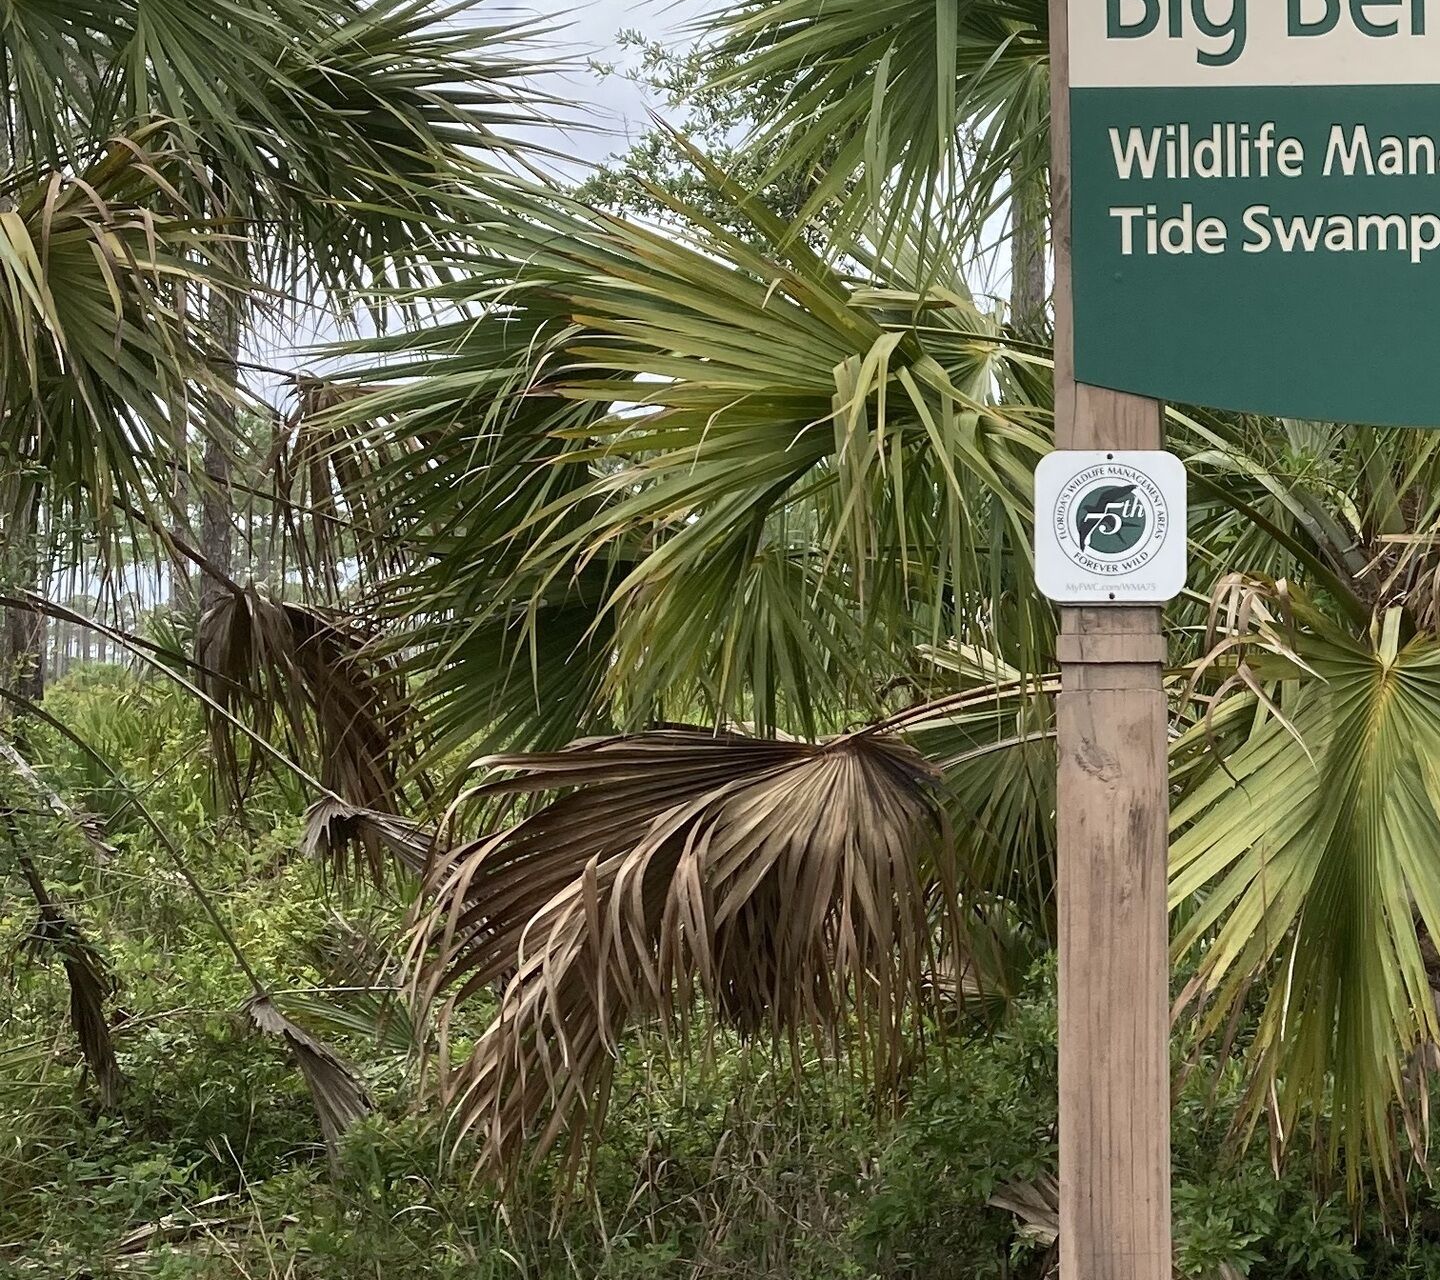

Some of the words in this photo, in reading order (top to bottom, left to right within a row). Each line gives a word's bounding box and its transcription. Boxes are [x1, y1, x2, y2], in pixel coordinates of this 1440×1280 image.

[1108, 123, 1305, 180] Wildlife
[1109, 204, 1228, 255] Tide
[1057, 493, 1070, 540] FLORIDA'S
[1068, 467, 1105, 495] WILDLIFE
[1107, 467, 1163, 507] MANAGEMENT
[1155, 509, 1166, 540] AREAS
[1083, 494, 1144, 546] 75th
[1073, 552, 1119, 573] FOREVER
[1122, 551, 1149, 570] WILD
